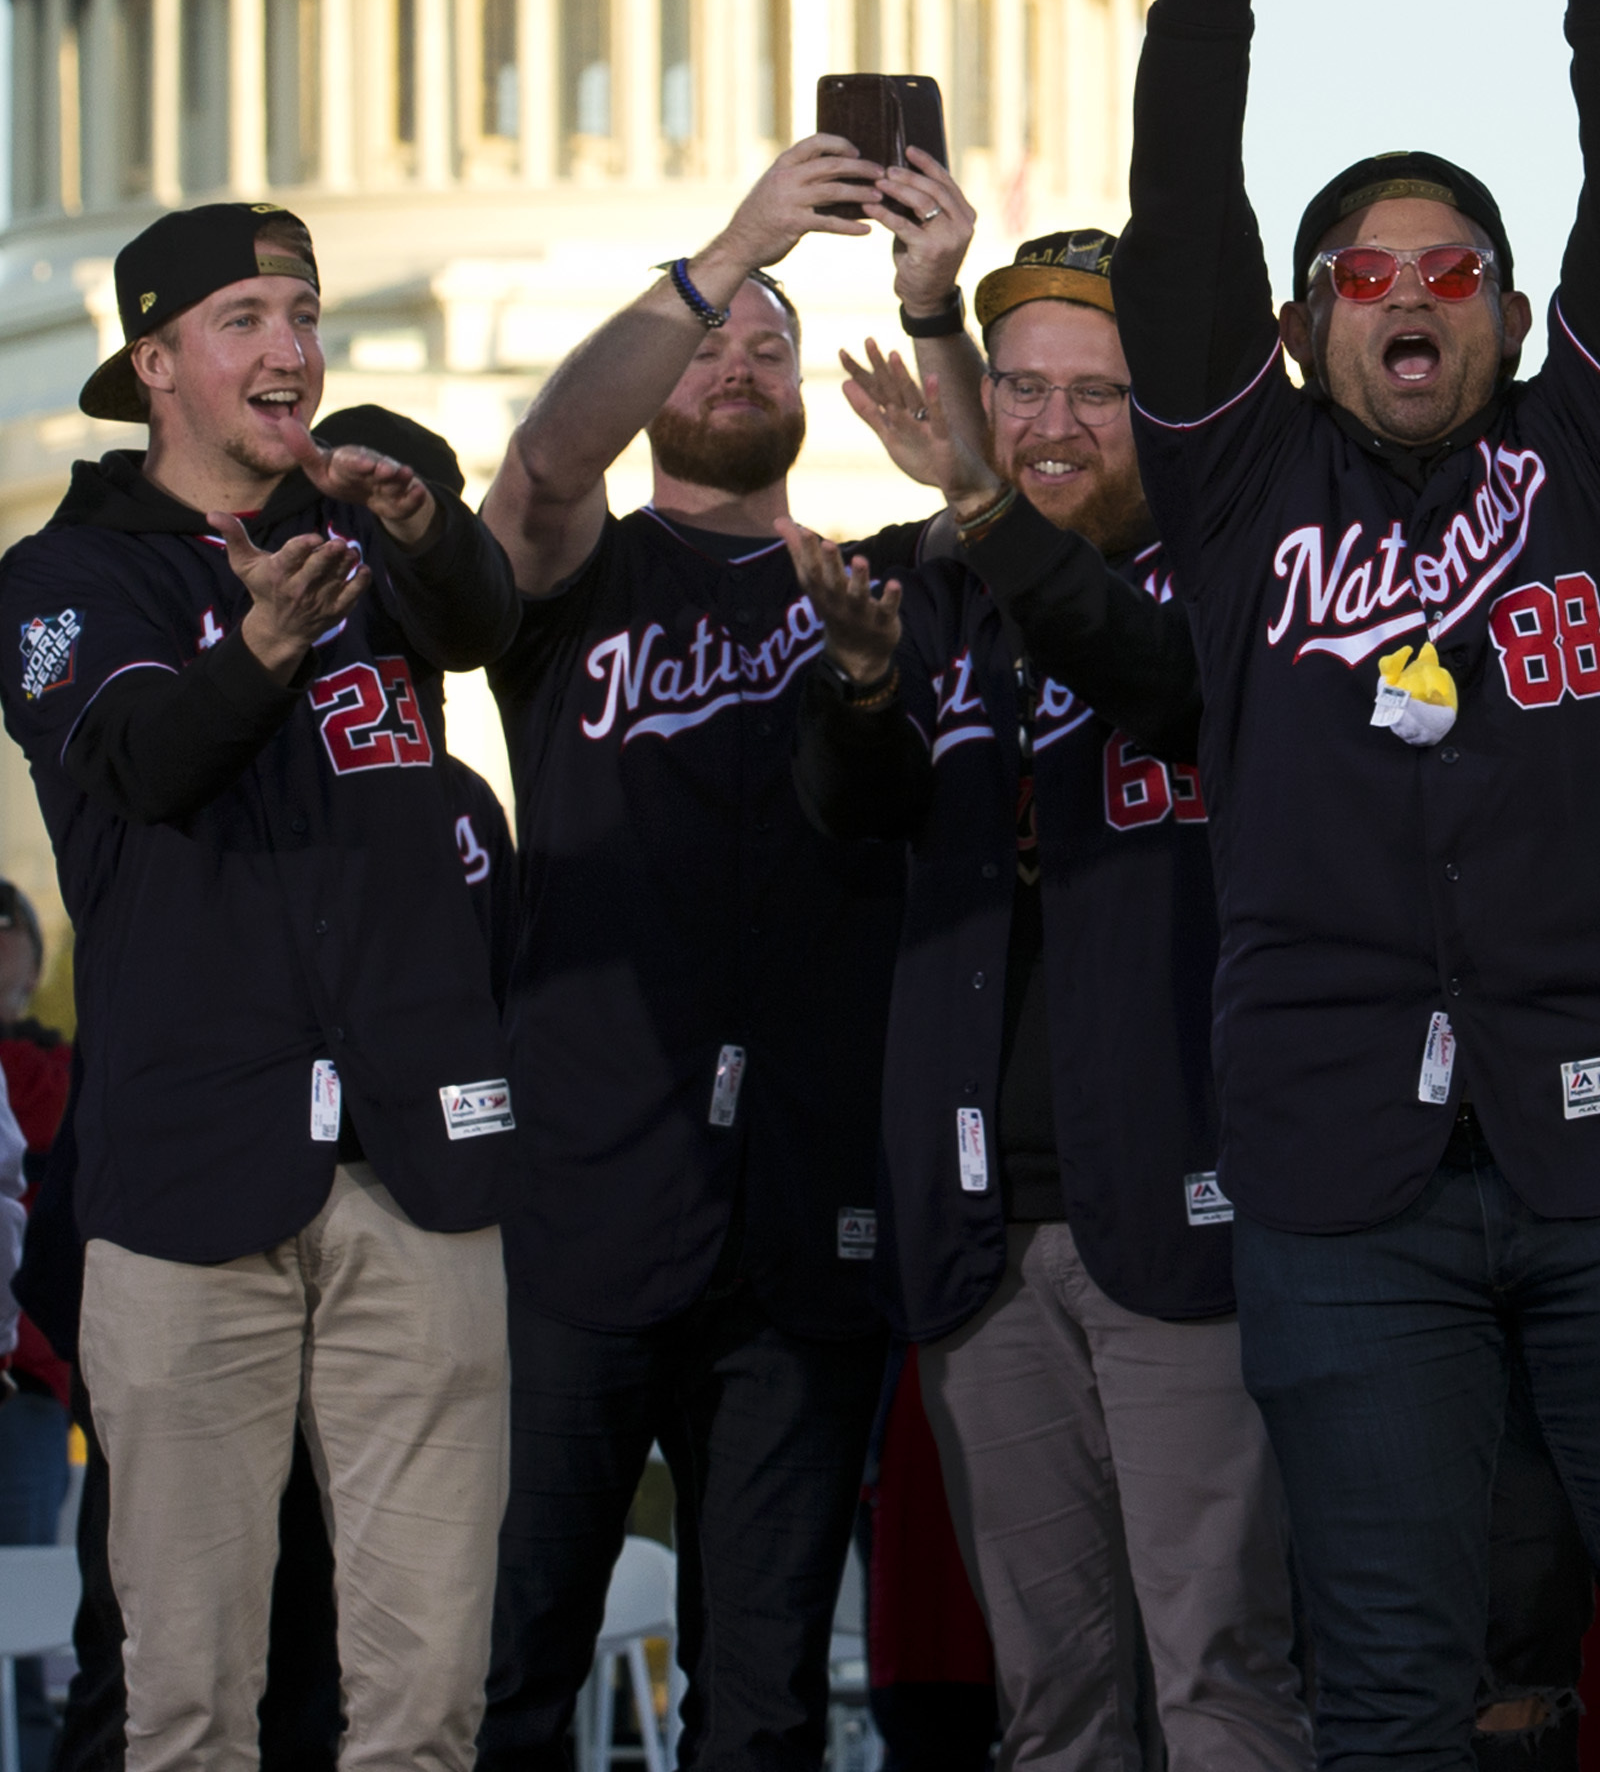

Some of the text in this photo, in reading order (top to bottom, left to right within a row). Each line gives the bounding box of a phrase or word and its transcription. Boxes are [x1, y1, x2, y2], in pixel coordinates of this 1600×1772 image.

[1265, 435, 1548, 668] Natonals
[21, 608, 77, 691] WORLD
[31, 621, 81, 700] SERIES
[580, 592, 828, 752] Nationa
[307, 654, 435, 776] 23
